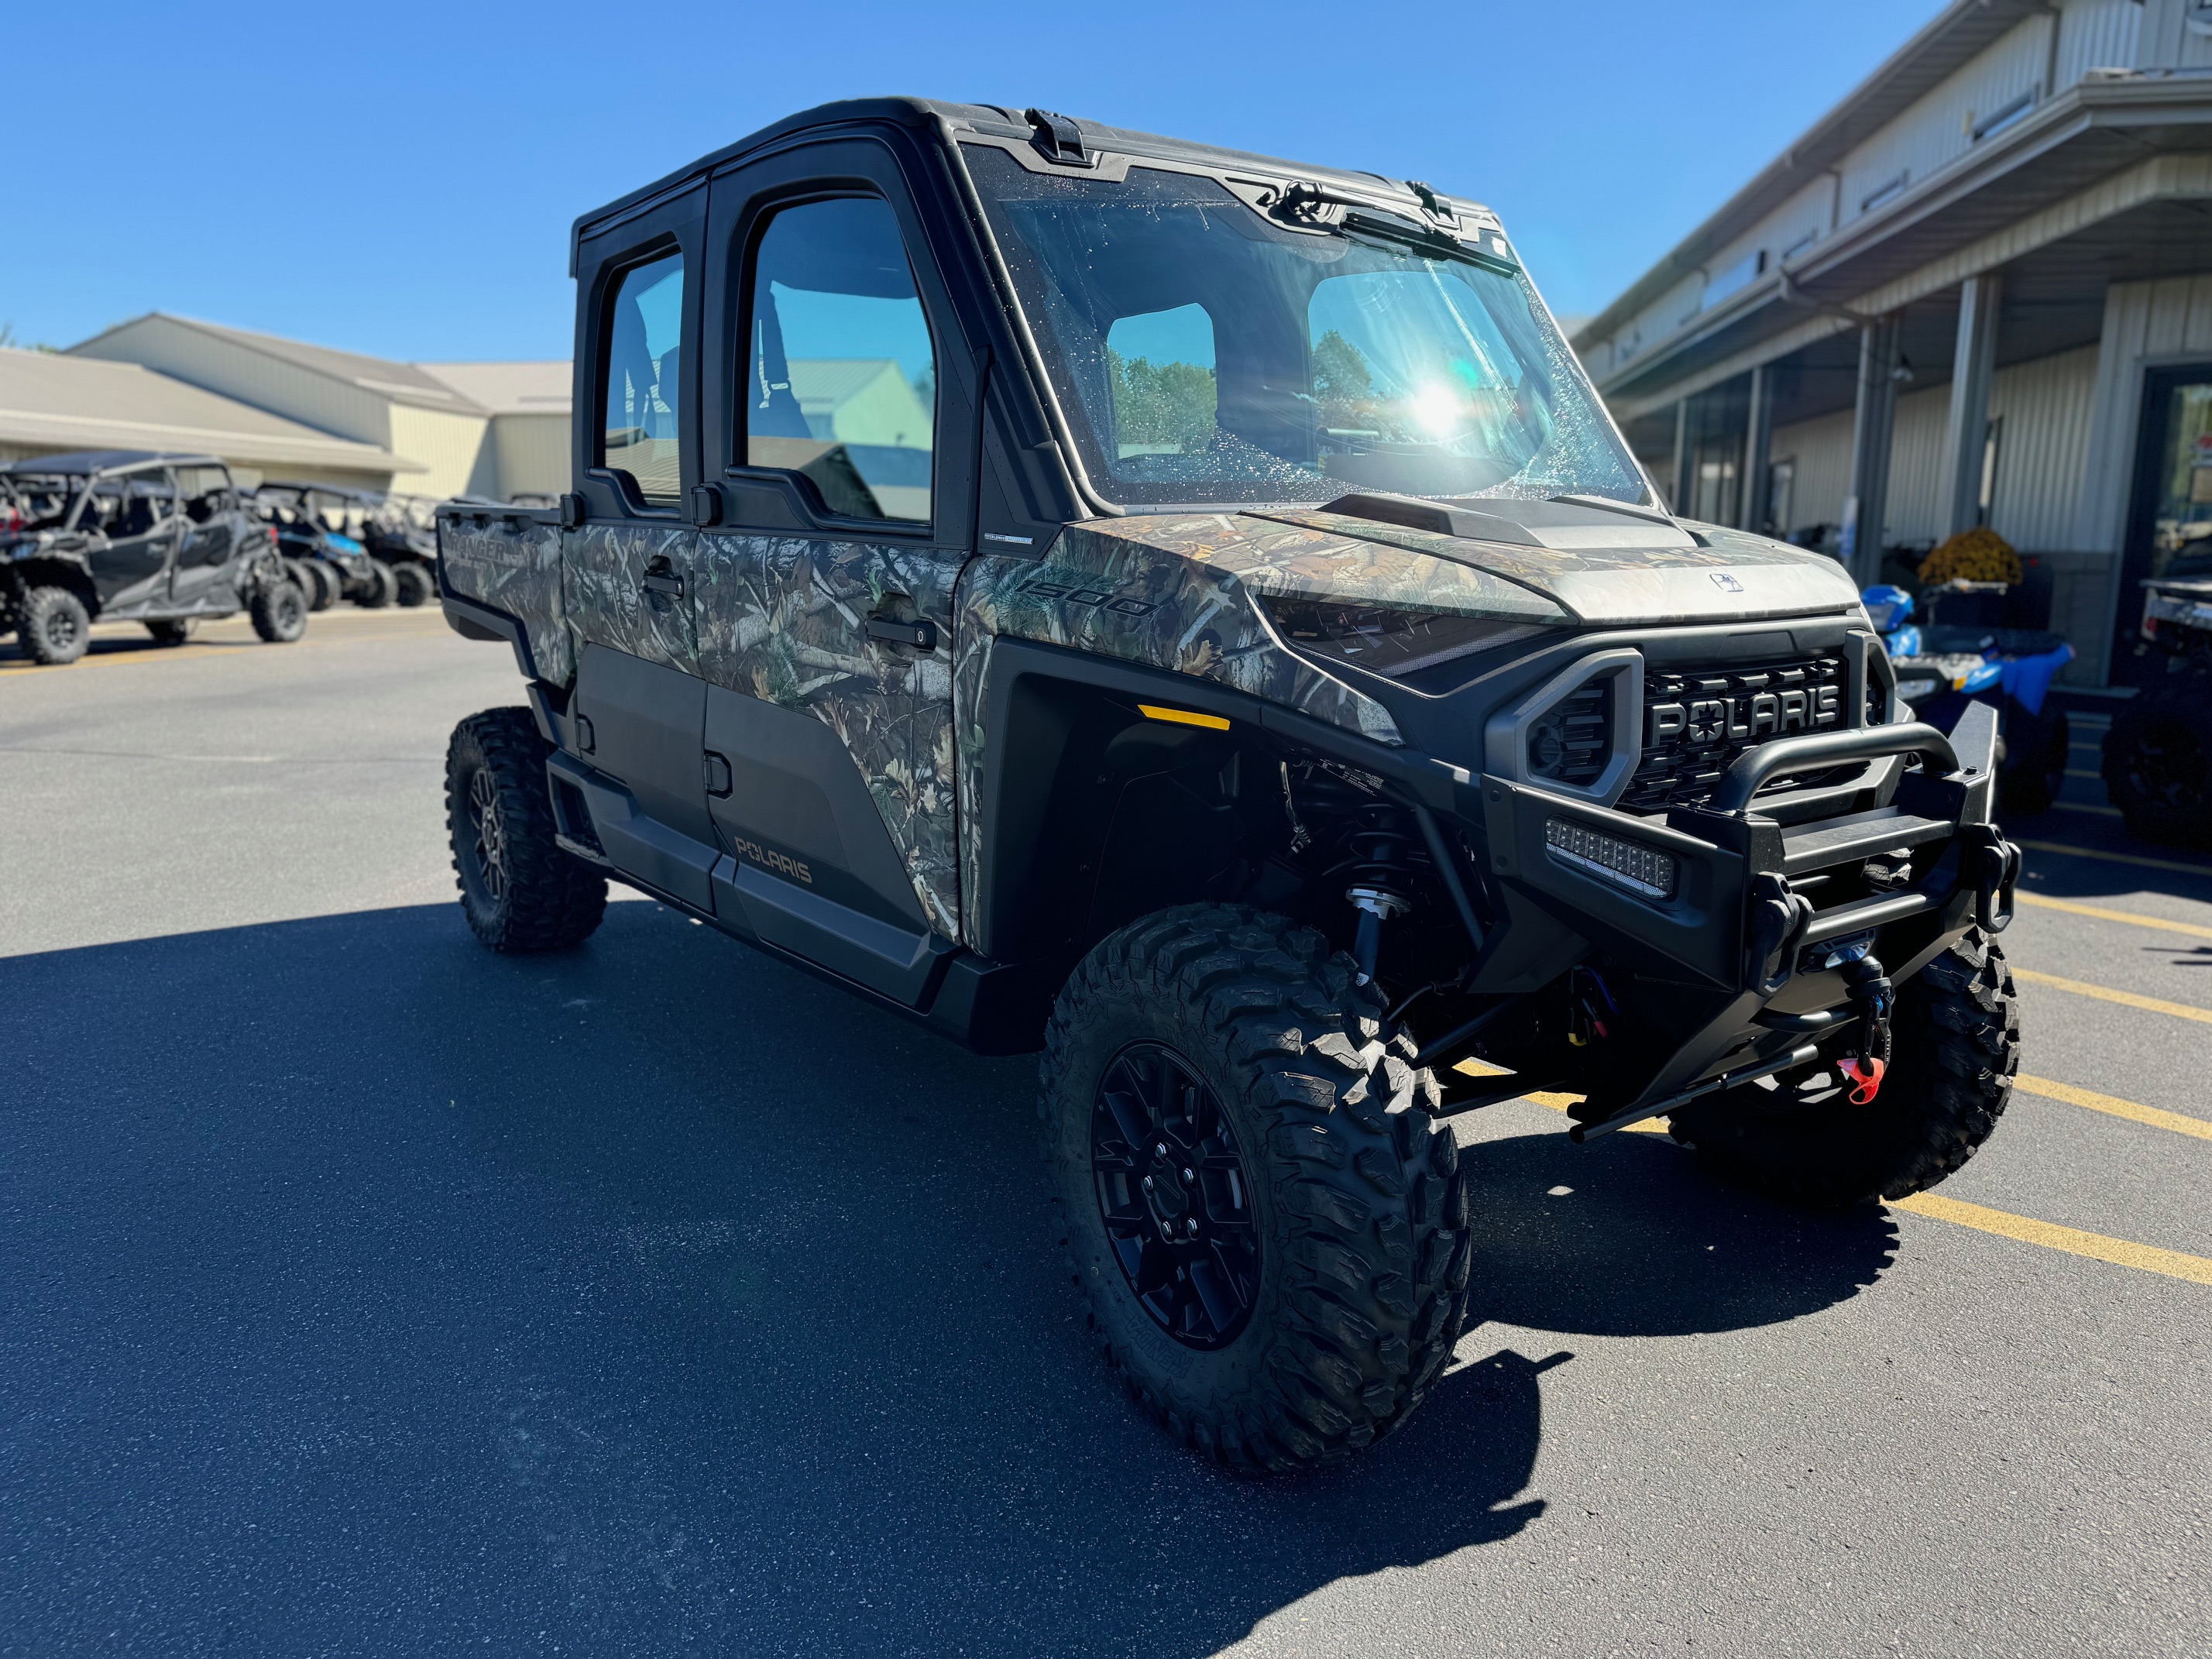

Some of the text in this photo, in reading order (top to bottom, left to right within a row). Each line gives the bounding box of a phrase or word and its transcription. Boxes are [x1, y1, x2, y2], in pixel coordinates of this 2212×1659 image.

[450, 533, 506, 562] RANGER
[1015, 579, 1160, 618] 1500
[1650, 685, 1839, 747] POLARIS
[734, 836, 812, 884] POLARIS
[1125, 1314, 1194, 1379] KENDA
